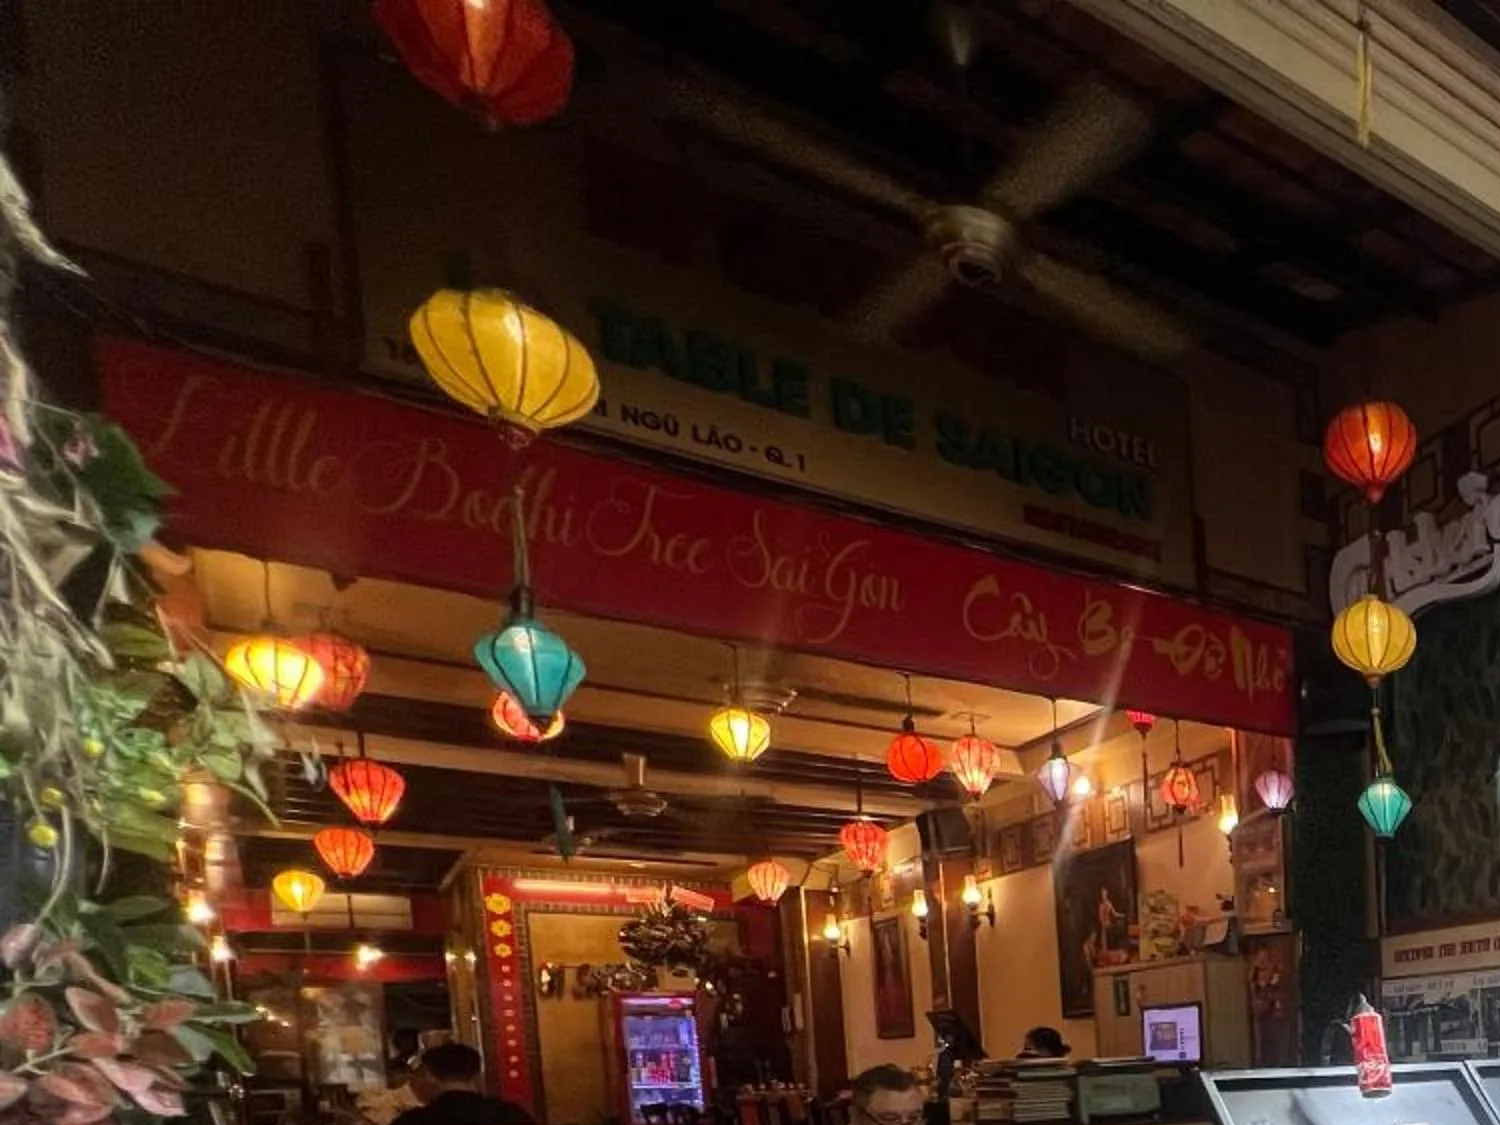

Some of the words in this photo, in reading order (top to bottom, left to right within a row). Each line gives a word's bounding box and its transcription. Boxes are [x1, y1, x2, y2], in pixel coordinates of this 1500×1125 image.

[830, 375, 917, 450] DE
[1067, 413, 1160, 470] HOTEL
[586, 475, 706, 575] Tree
